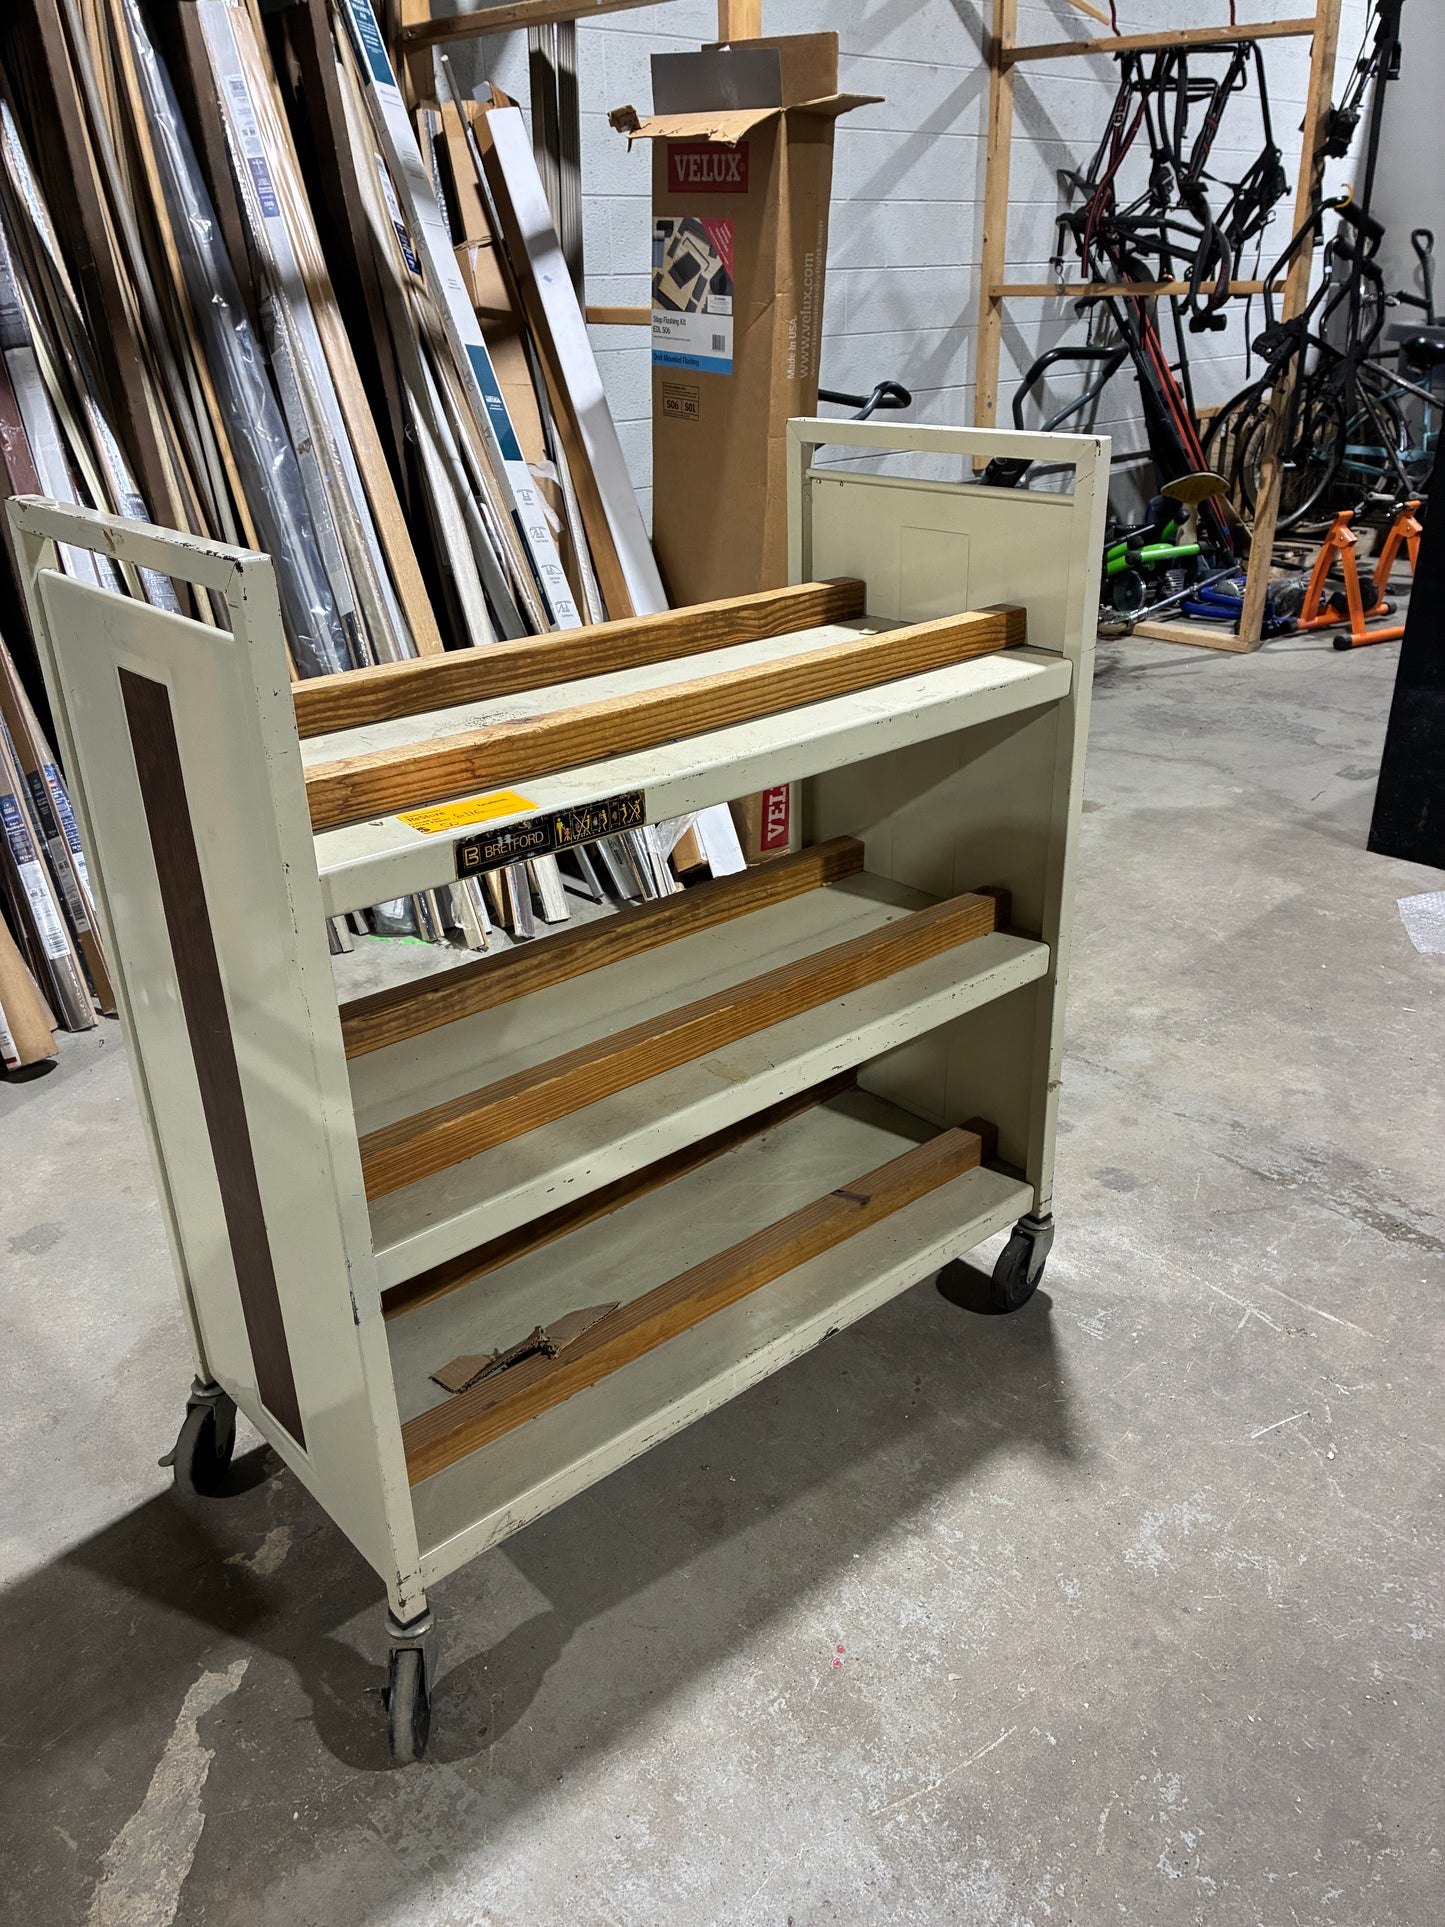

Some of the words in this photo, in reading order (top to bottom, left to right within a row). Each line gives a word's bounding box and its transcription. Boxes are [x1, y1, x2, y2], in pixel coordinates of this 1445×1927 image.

[674, 153, 742, 182] VELUX
[800, 252, 815, 378] www.velux.com
[786, 352, 796, 379] Made
[666, 400, 679, 410] S06
[768, 783, 788, 842] VEL
[484, 831, 544, 858] BRETFORD
